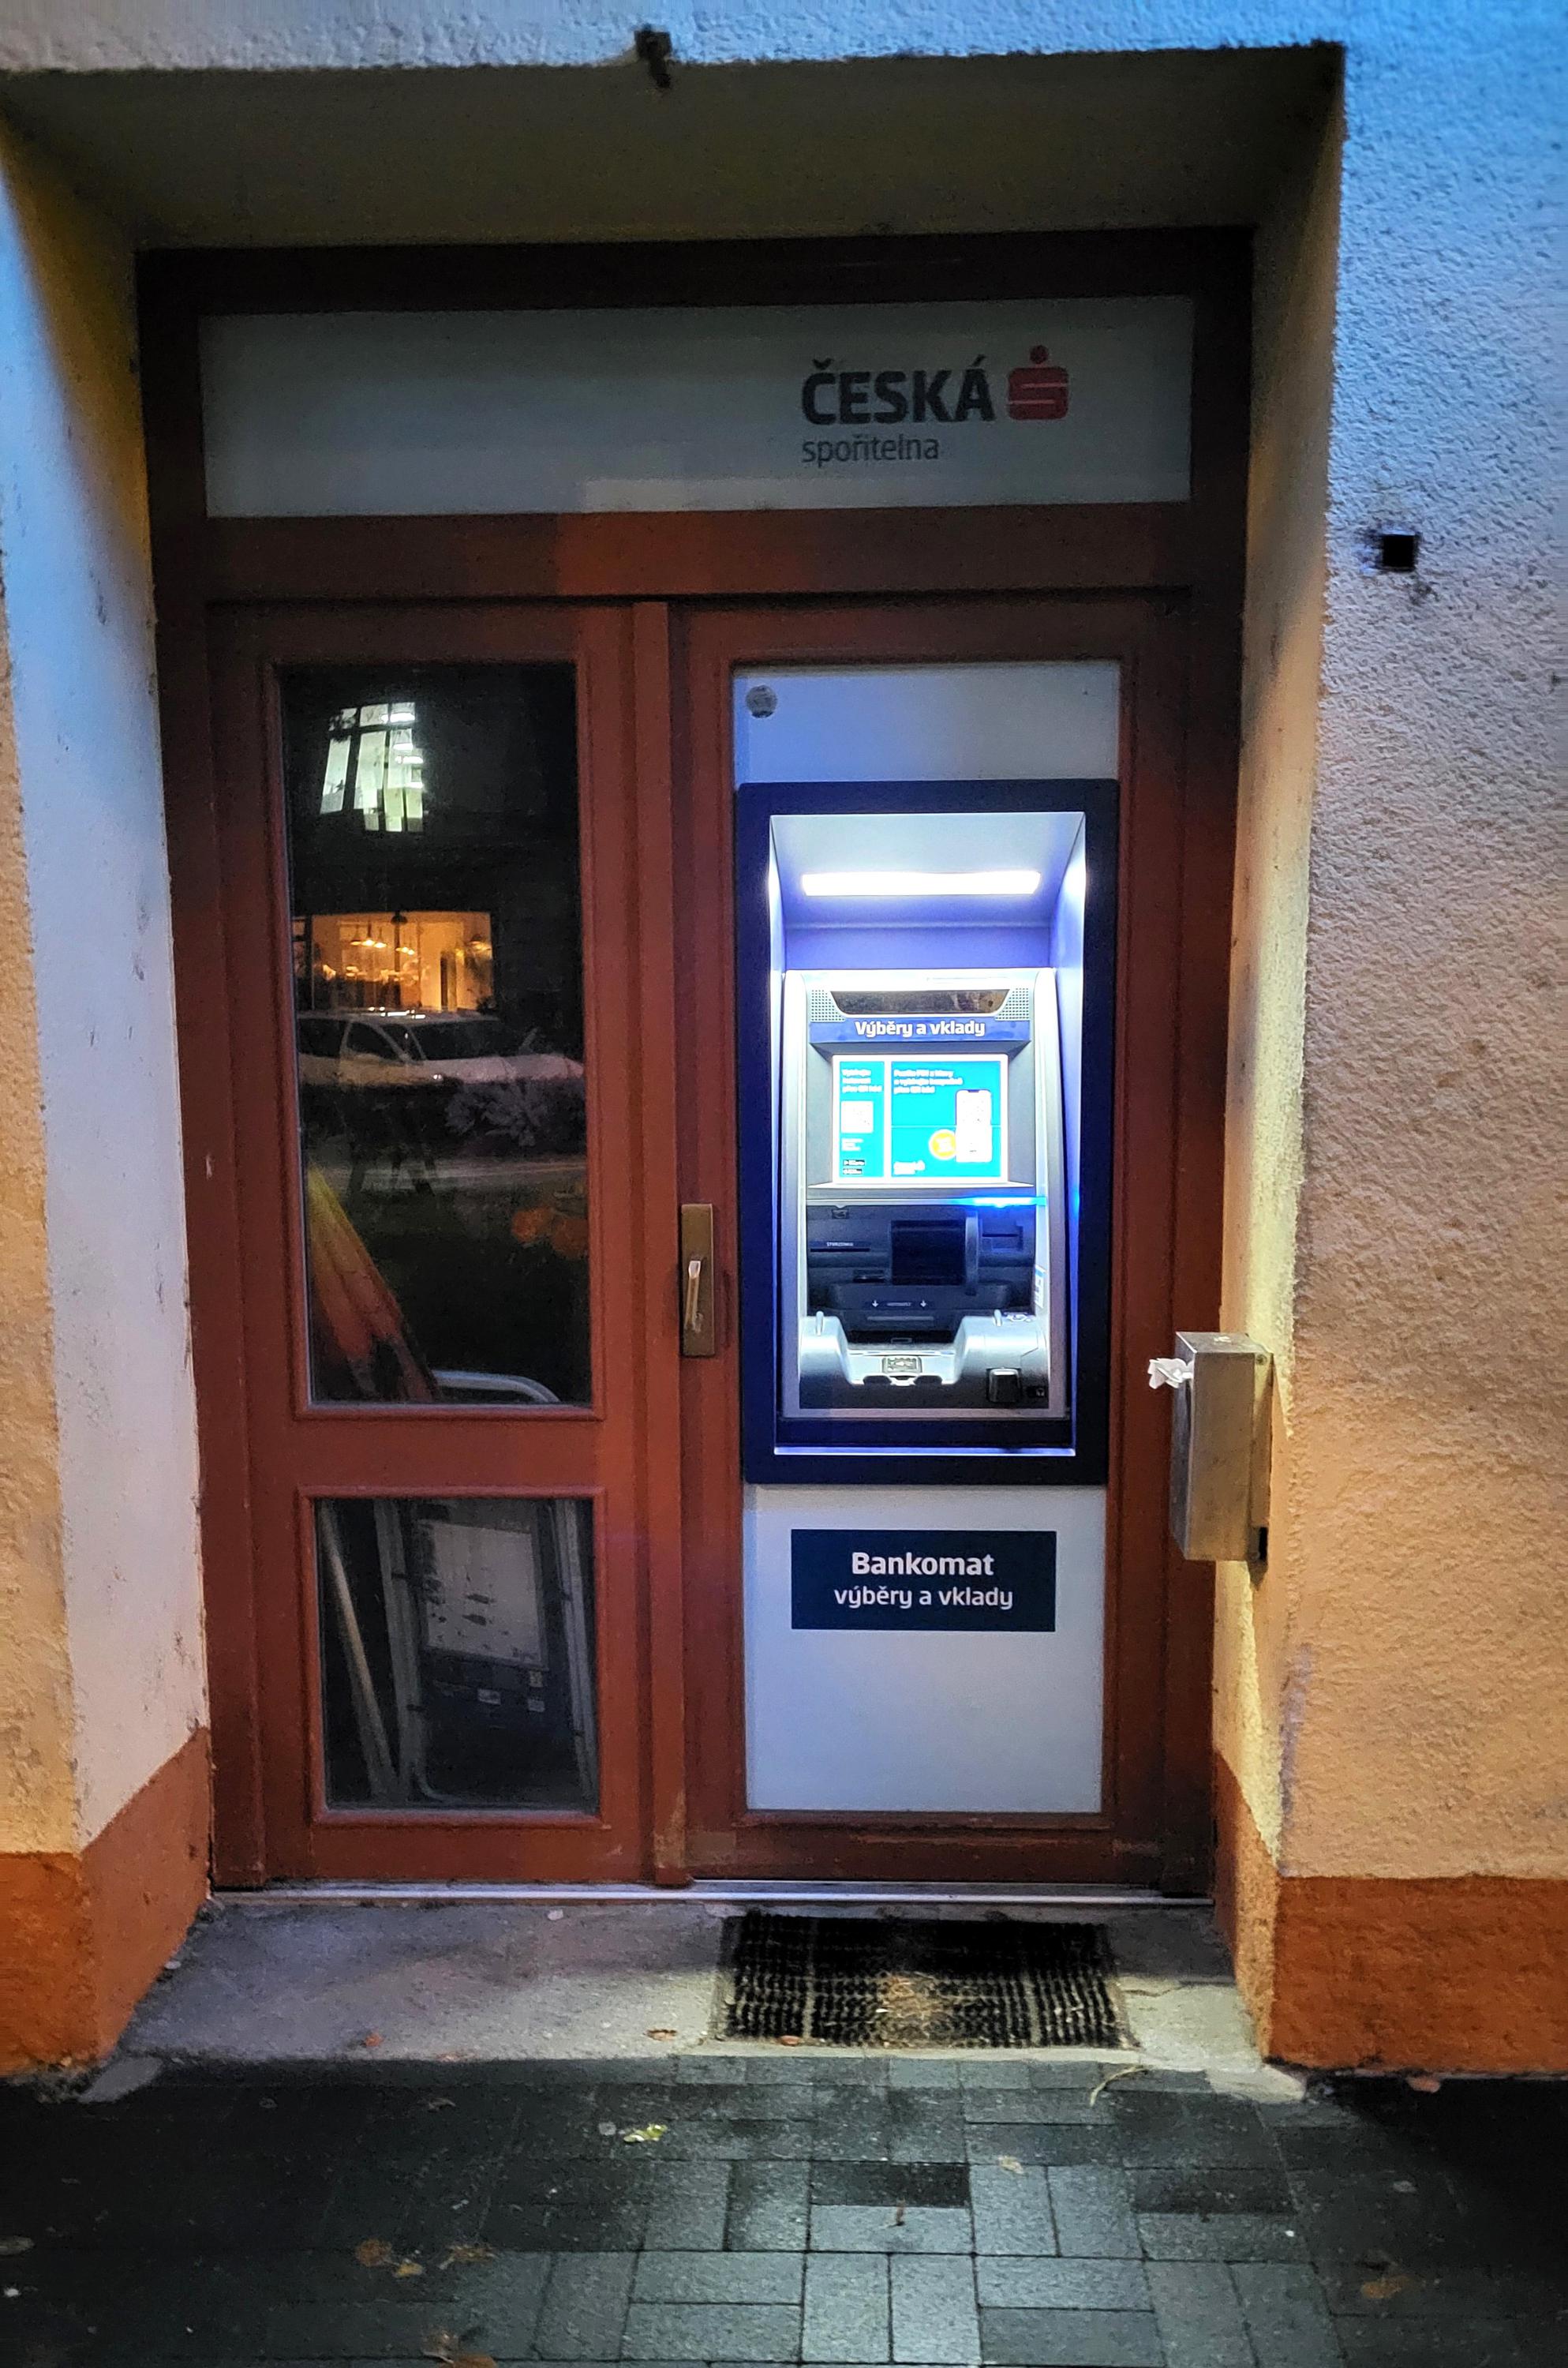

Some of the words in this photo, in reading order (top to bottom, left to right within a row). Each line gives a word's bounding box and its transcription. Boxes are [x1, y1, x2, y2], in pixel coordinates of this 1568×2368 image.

[802, 355, 995, 425] ČESKÁ
[855, 1021, 913, 1037] Výběry
[916, 1025, 926, 1035] a
[930, 1021, 985, 1036] vklady
[851, 1552, 994, 1576] Bankomat
[833, 1585, 912, 1609] výběry
[919, 1590, 932, 1605] a
[938, 1587, 1013, 1610] vklady
